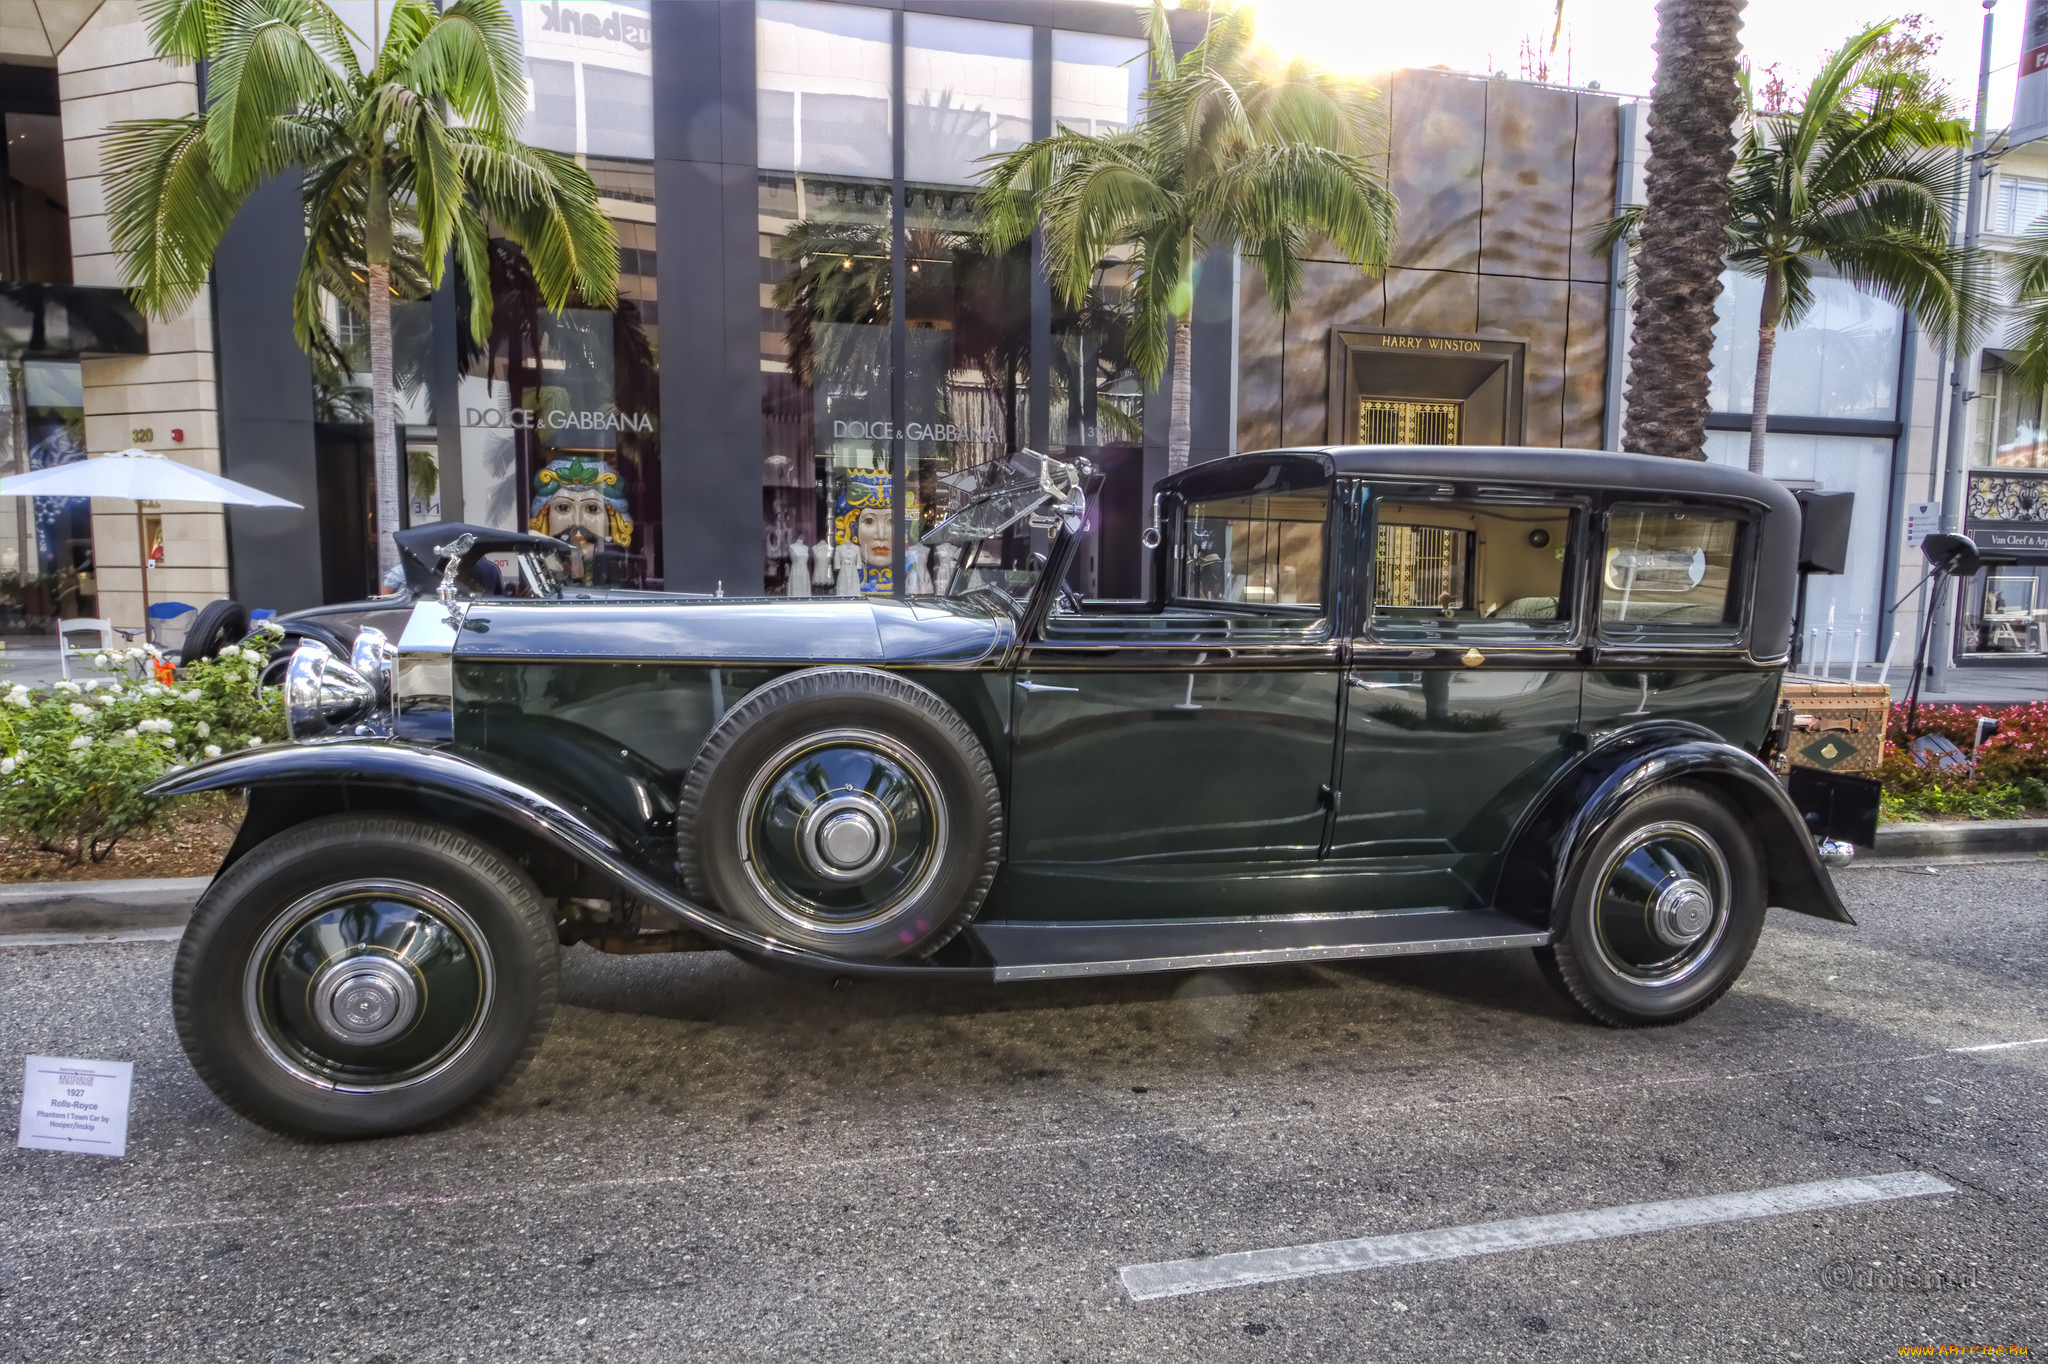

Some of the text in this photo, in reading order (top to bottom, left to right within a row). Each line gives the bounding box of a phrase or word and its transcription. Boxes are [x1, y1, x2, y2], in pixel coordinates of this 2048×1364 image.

[1382, 335, 1481, 352] HARRY WINSTON
[466, 407, 654, 432] DOLCE & GABBANA
[132, 428, 154, 443] 320
[833, 420, 999, 443] DOLCE & GABBANA
[1991, 534, 2006, 544] Van
[2007, 535, 2028, 545] Cleef
[2028, 537, 2035, 545] &
[67, 1088, 85, 1097] 1927
[51, 1099, 98, 1111] Rolls-Royce
[37, 1110, 66, 1119] Phantom
[71, 1113, 88, 1121] Town
[101, 1116, 110, 1124] by
